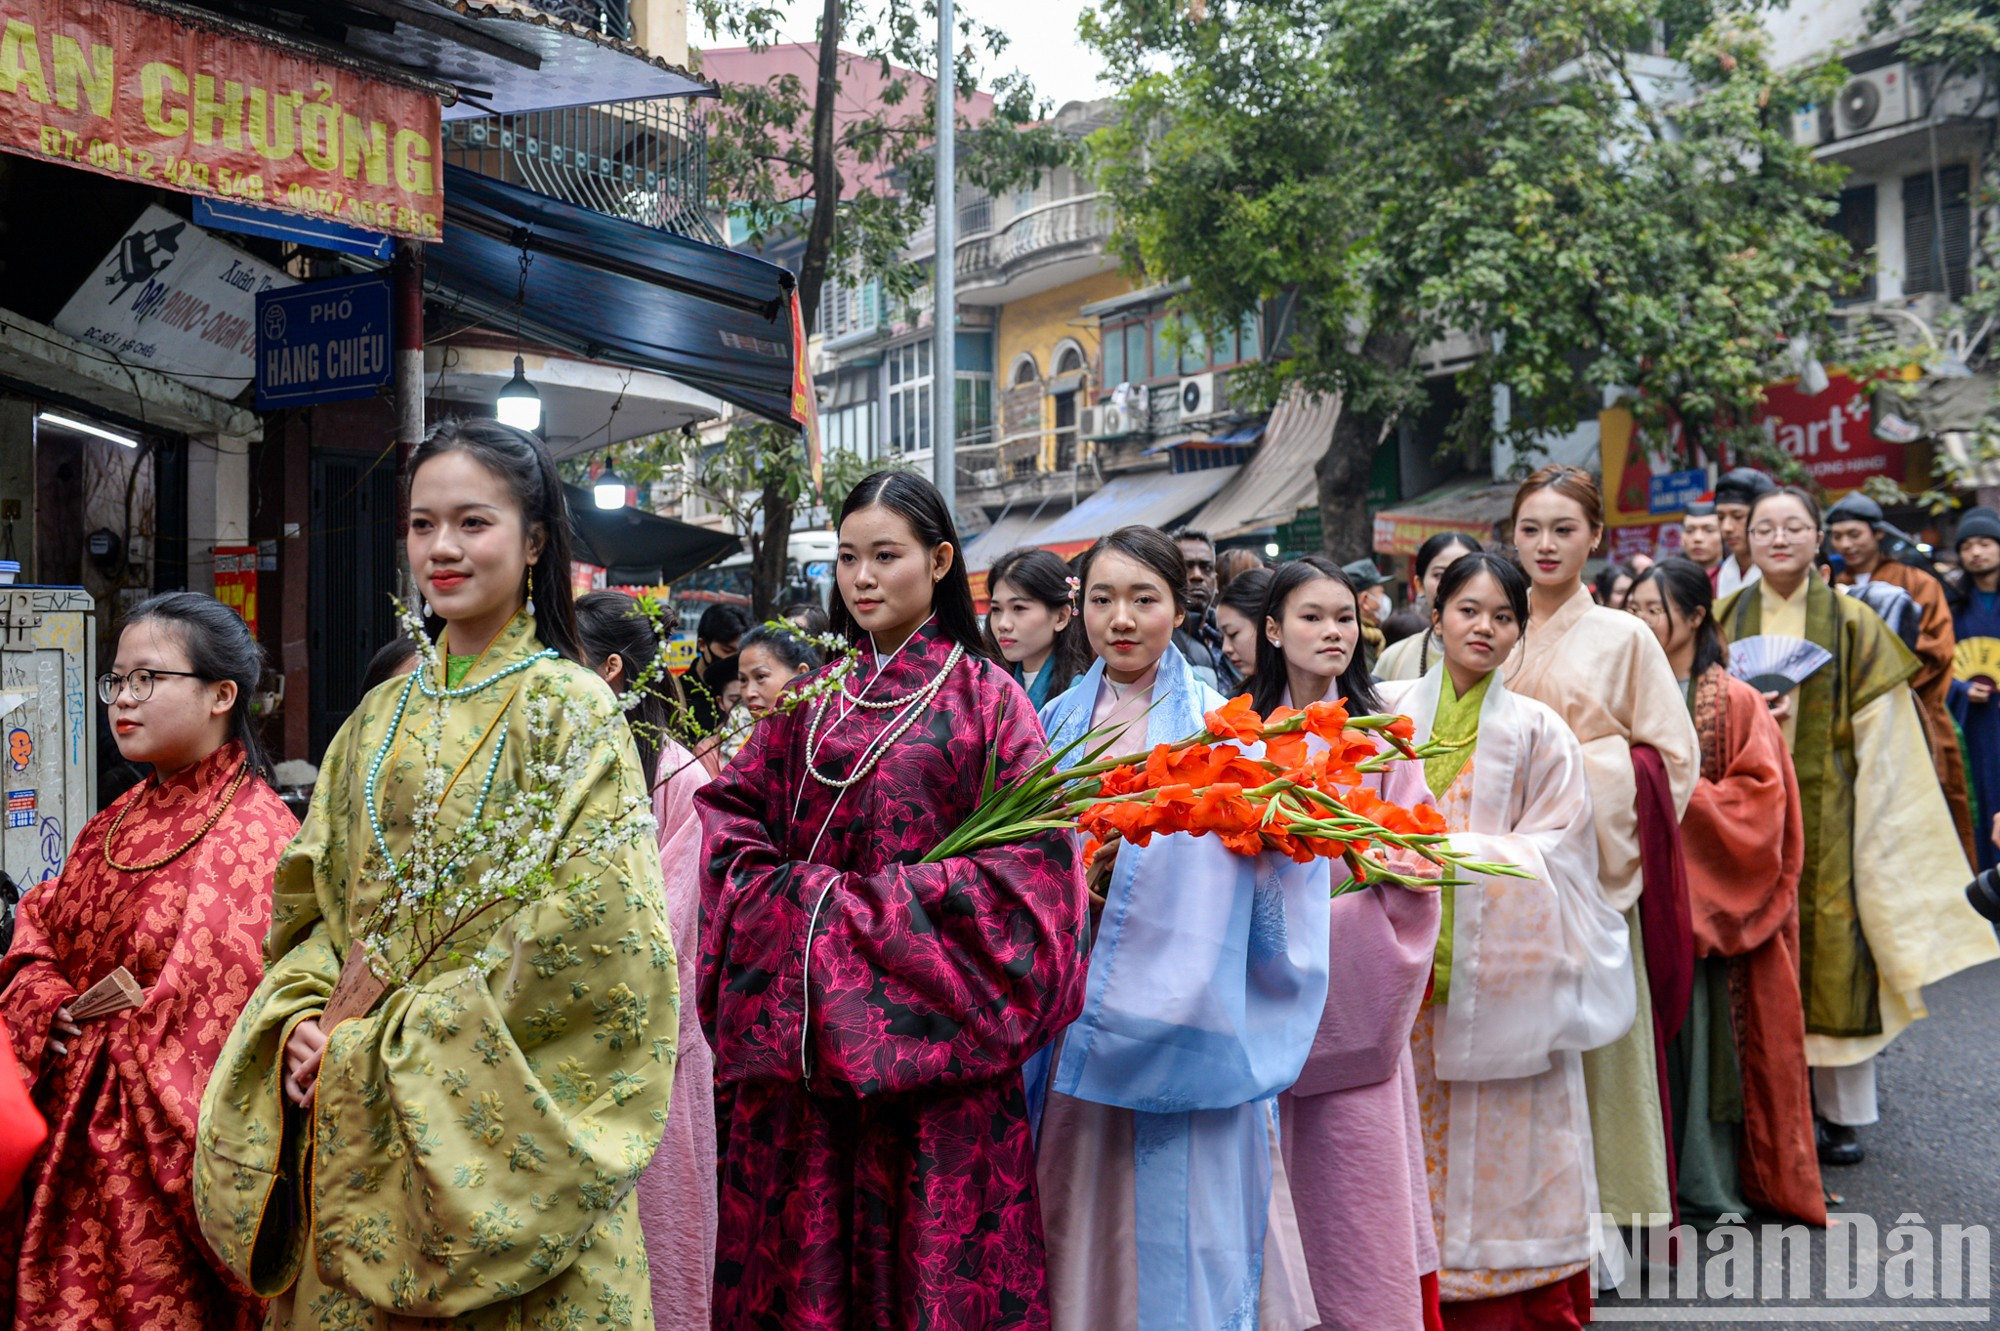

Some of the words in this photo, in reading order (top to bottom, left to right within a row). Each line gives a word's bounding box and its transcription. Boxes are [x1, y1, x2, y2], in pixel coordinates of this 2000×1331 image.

[0, 18, 114, 120] AN
[140, 62, 434, 196] CHƯỞNG
[89, 139, 155, 180] 0912
[218, 167, 265, 200] 548
[288, 183, 343, 217] 0947
[219, 259, 256, 293] Xuân
[310, 290, 354, 324] PHỐ
[267, 338, 319, 388] HÀNG
[327, 322, 384, 379] CHIẾU
